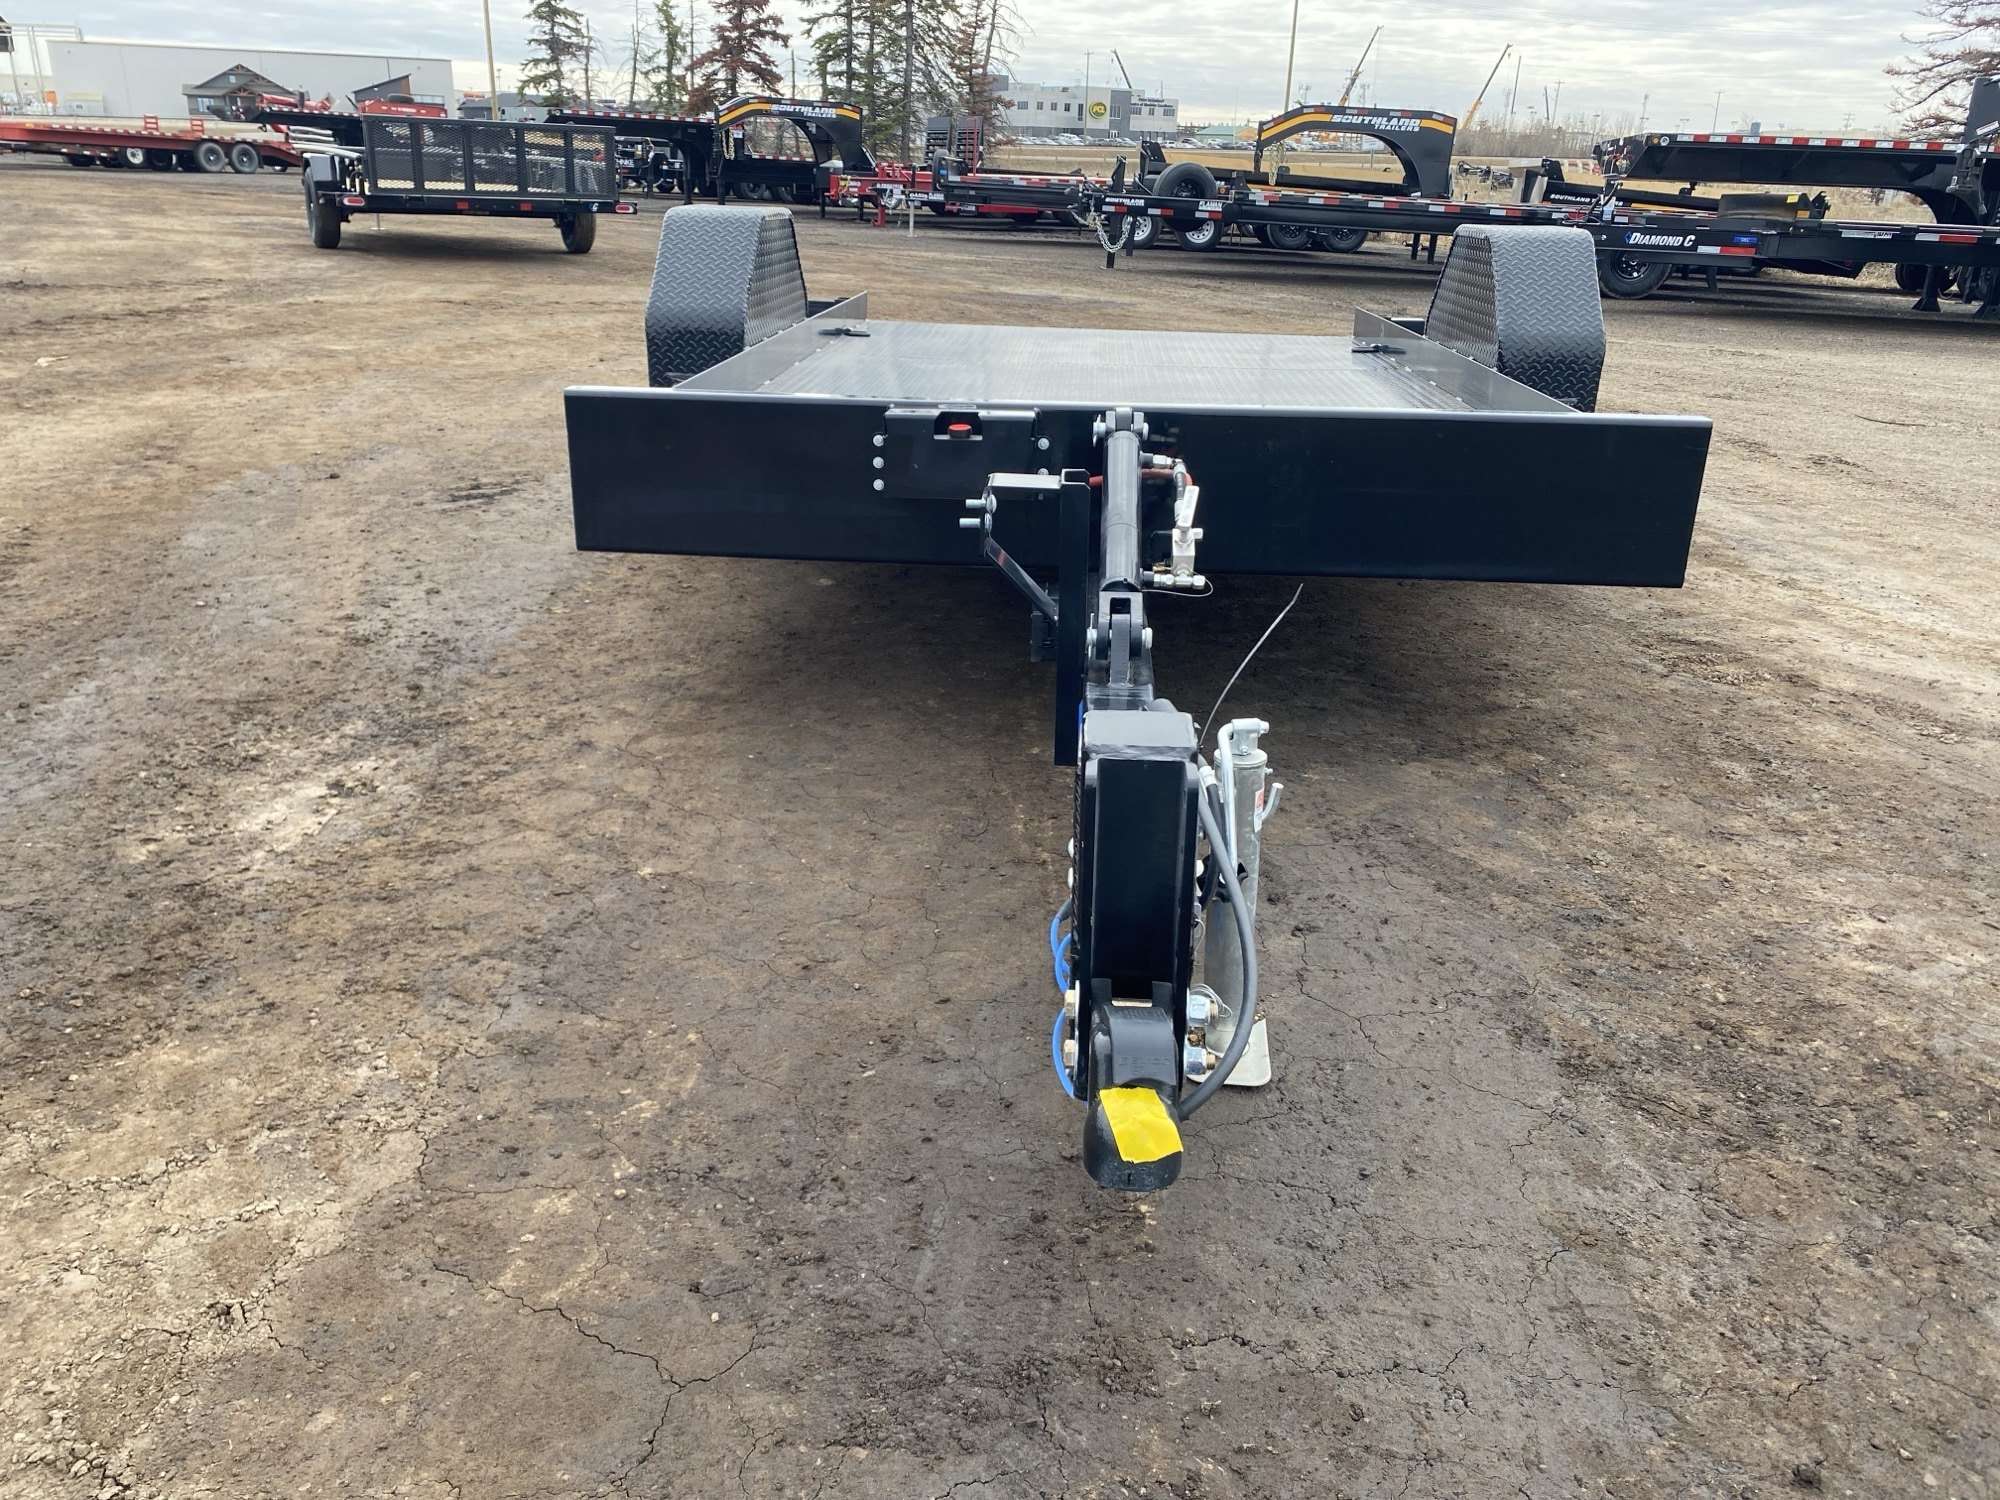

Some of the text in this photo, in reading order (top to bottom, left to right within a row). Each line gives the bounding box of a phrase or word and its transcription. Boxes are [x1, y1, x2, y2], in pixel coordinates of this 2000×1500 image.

[771, 103, 837, 114] SOUTHLAND
[1331, 114, 1420, 126] SOUTHLAND
[1374, 124, 1420, 132] TRAILERS
[1550, 193, 1591, 203] SOUTHLAND
[1629, 232, 1696, 247] DIAMOND C
